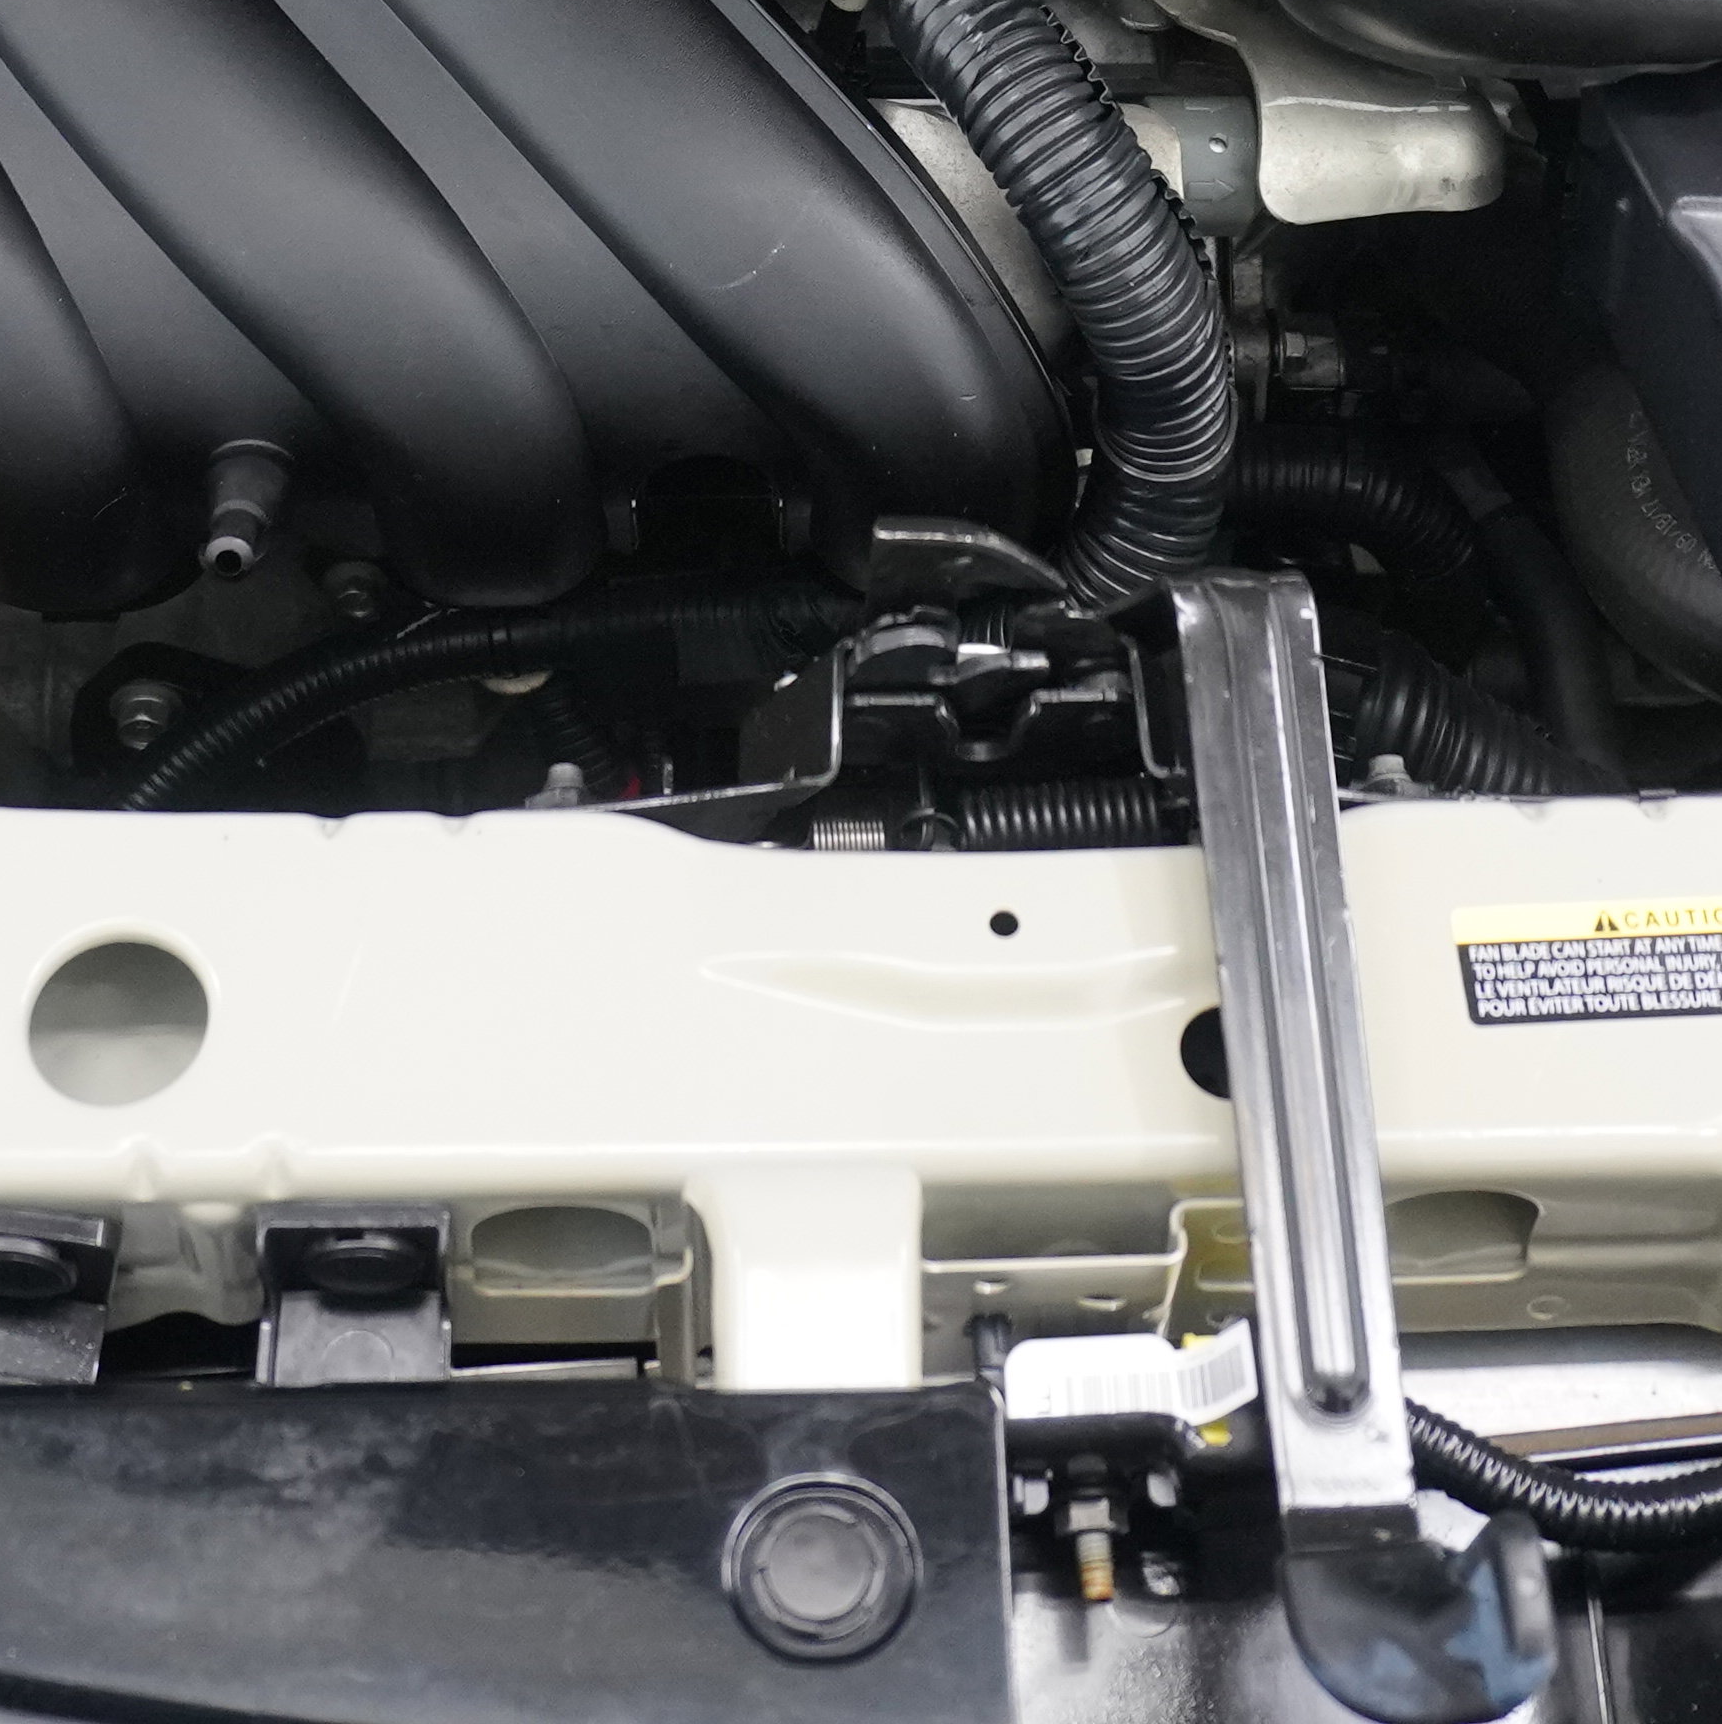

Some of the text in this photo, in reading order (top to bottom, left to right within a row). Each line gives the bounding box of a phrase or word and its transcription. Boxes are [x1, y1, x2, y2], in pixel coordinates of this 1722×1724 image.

[1469, 943, 1500, 962] FAN
[1500, 942, 1550, 962] BLADE
[1551, 940, 1586, 960] CAN
[1586, 938, 1632, 958] START
[1634, 937, 1652, 956] AT
[1654, 936, 1687, 955] ANY
[1474, 962, 1496, 980] TO
[1497, 960, 1536, 980] HELP
[1537, 958, 1585, 978] AVOID
[1585, 955, 1664, 976] PERSONAL
[1475, 980, 1496, 999] LE
[1496, 976, 1606, 998] VENTILATEUR
[1606, 973, 1667, 994] RISQUE
[1668, 972, 1693, 991] DE
[1478, 998, 1527, 1018] POUR
[1585, 993, 1640, 1013] TOUTE
